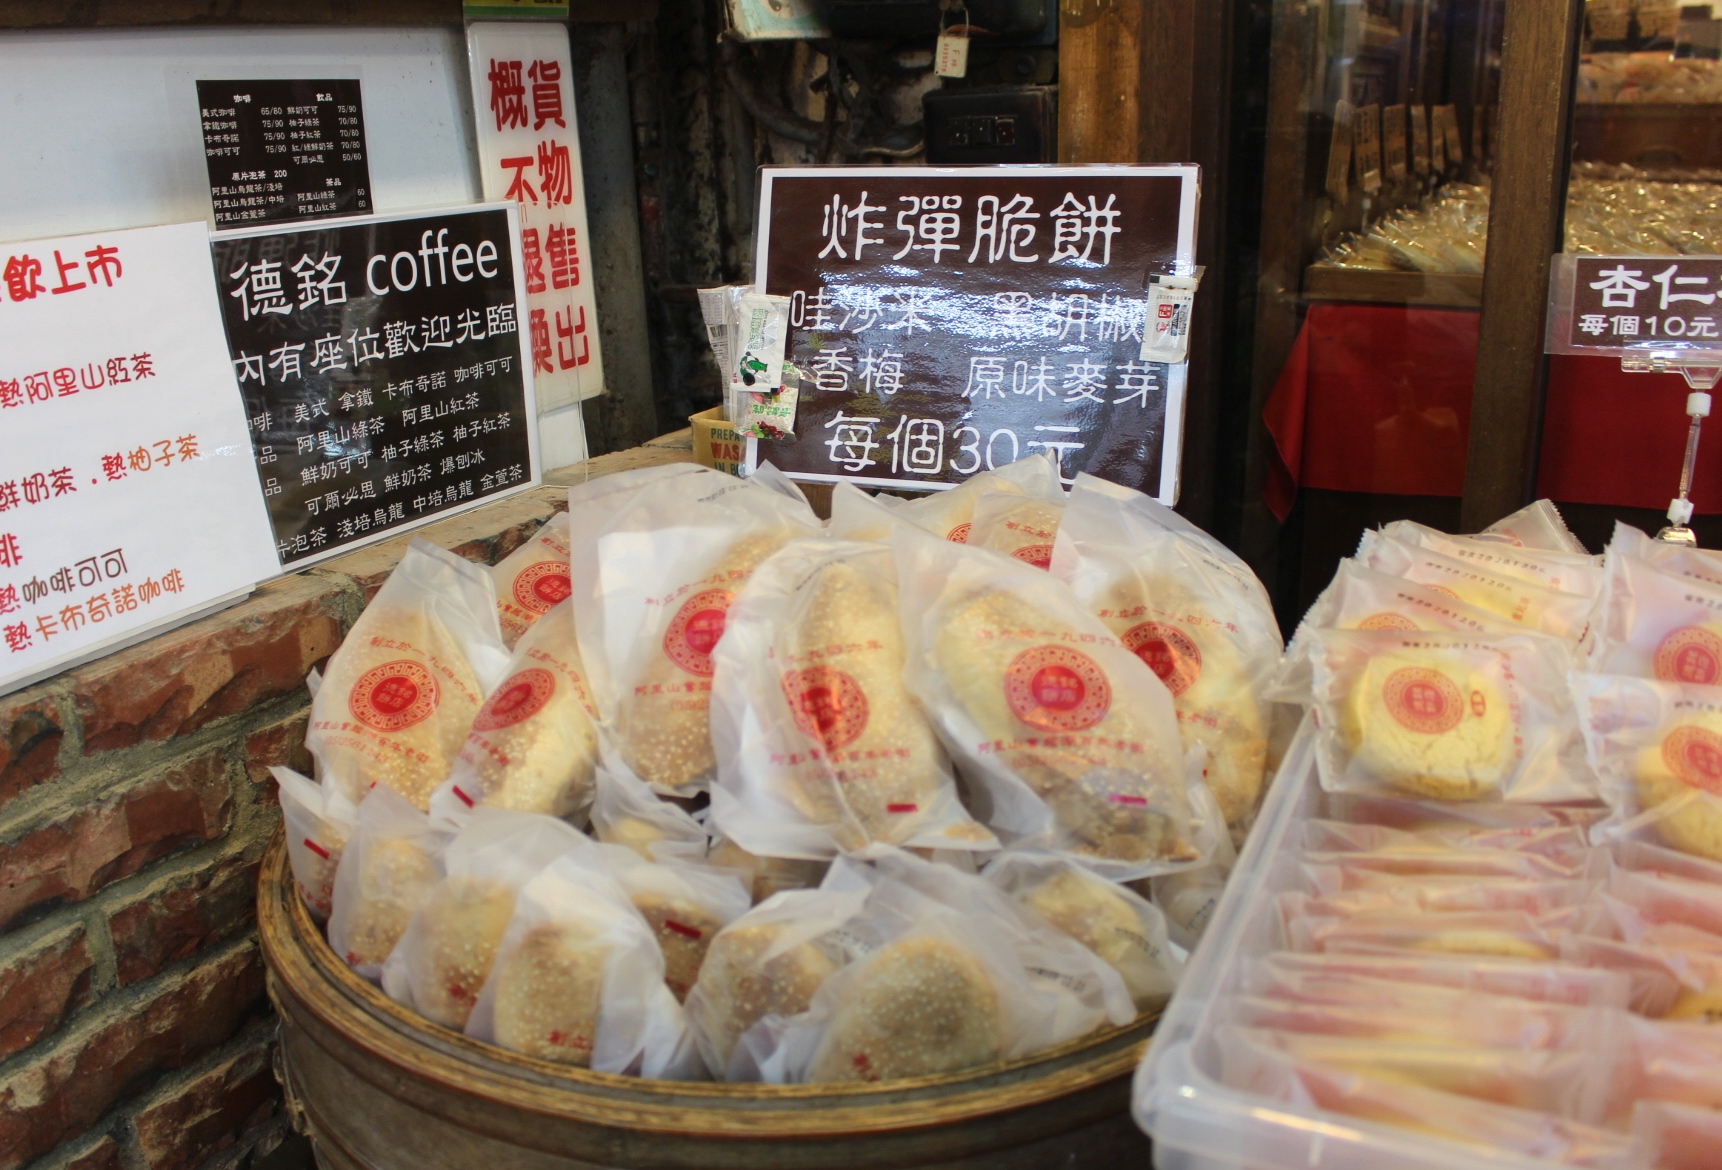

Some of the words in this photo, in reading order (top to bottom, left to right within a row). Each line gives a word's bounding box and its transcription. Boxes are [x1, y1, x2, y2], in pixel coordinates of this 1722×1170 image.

[233, 94, 252, 104] 咖啡
[316, 92, 333, 102] 飲品
[202, 108, 236, 118] 美式咖啡
[260, 106, 283, 116] 65/80
[337, 105, 357, 114] 75/90
[262, 119, 284, 128] 75/90
[338, 117, 358, 126] 70/80
[263, 132, 286, 141] 75/90
[339, 128, 360, 138] 70/80
[265, 144, 287, 154] 75/90
[340, 140, 361, 150] 70/80
[342, 152, 362, 162] 50/60
[273, 169, 288, 178] 200
[356, 188, 366, 197] 60
[358, 200, 367, 208] 60
[818, 190, 1122, 265] 炸彈脆餅
[230, 251, 347, 321] 德銘
[366, 227, 499, 296] coffee
[1588, 264, 1722, 311] 杏仁
[1577, 313, 1720, 338] 每個10元
[812, 347, 905, 395] 香梅
[961, 356, 1162, 408] 原味麥芽
[294, 399, 330, 423] 美式
[338, 387, 374, 411] 拿鐵
[382, 370, 447, 401] 卡布奇諾
[453, 355, 513, 383] 咖啡可可
[296, 415, 386, 456] 阿里山綠茶
[402, 391, 481, 427] 阿里山紅茶
[300, 450, 371, 487] 鮮奶可可
[381, 429, 445, 463] 柚子綠茶
[452, 411, 512, 443] 柚子紅茶
[824, 410, 1085, 484] 每個30元
[304, 480, 377, 516] 可爾必思
[384, 462, 432, 493] 鮮奶茶
[336, 501, 405, 538] 淺培烏龍
[412, 479, 474, 513] 中培烏龍
[480, 463, 523, 491] 金萱茶
[3, 568, 186, 653] 熱卡布奇諾咖啡
